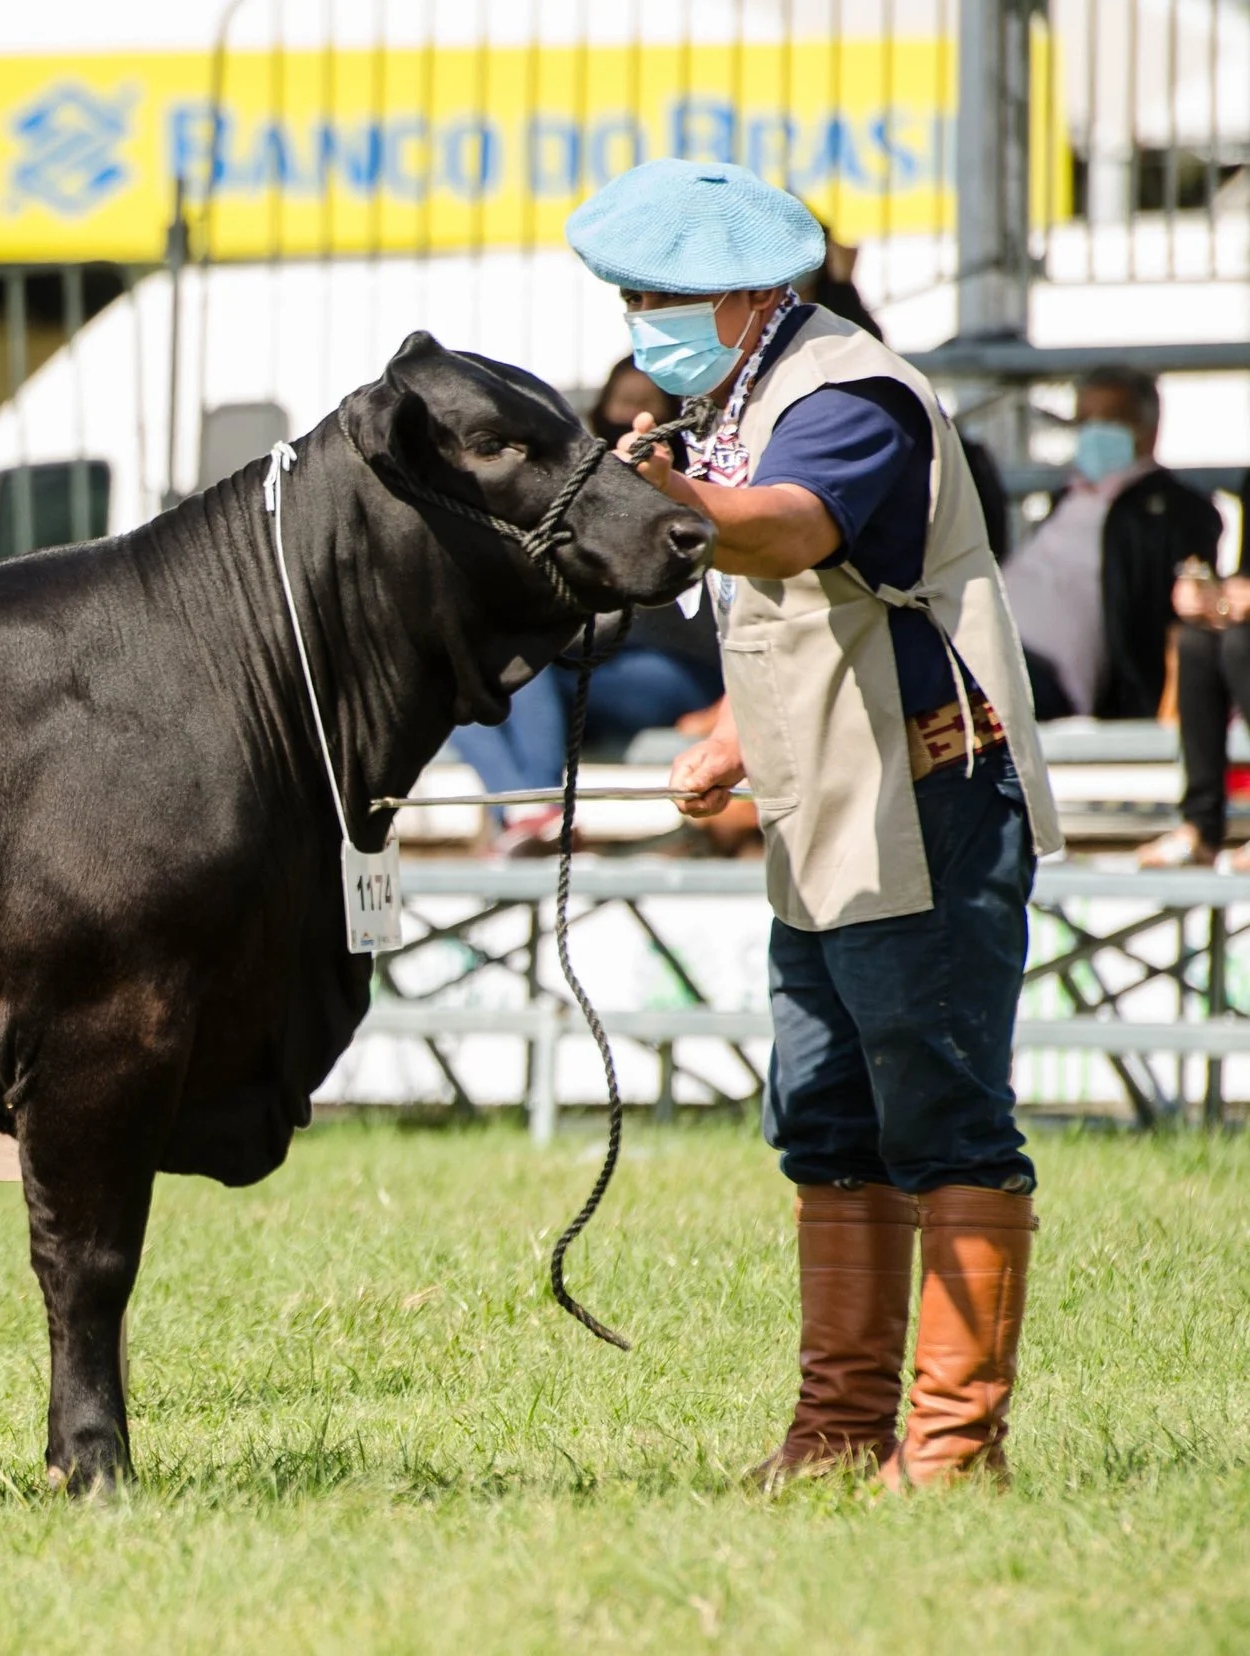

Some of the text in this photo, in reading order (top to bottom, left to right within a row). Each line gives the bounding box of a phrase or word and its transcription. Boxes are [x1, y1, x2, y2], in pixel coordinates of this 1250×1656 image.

[167, 95, 957, 198] BANCO DO BRASI
[356, 873, 393, 912] 1174
